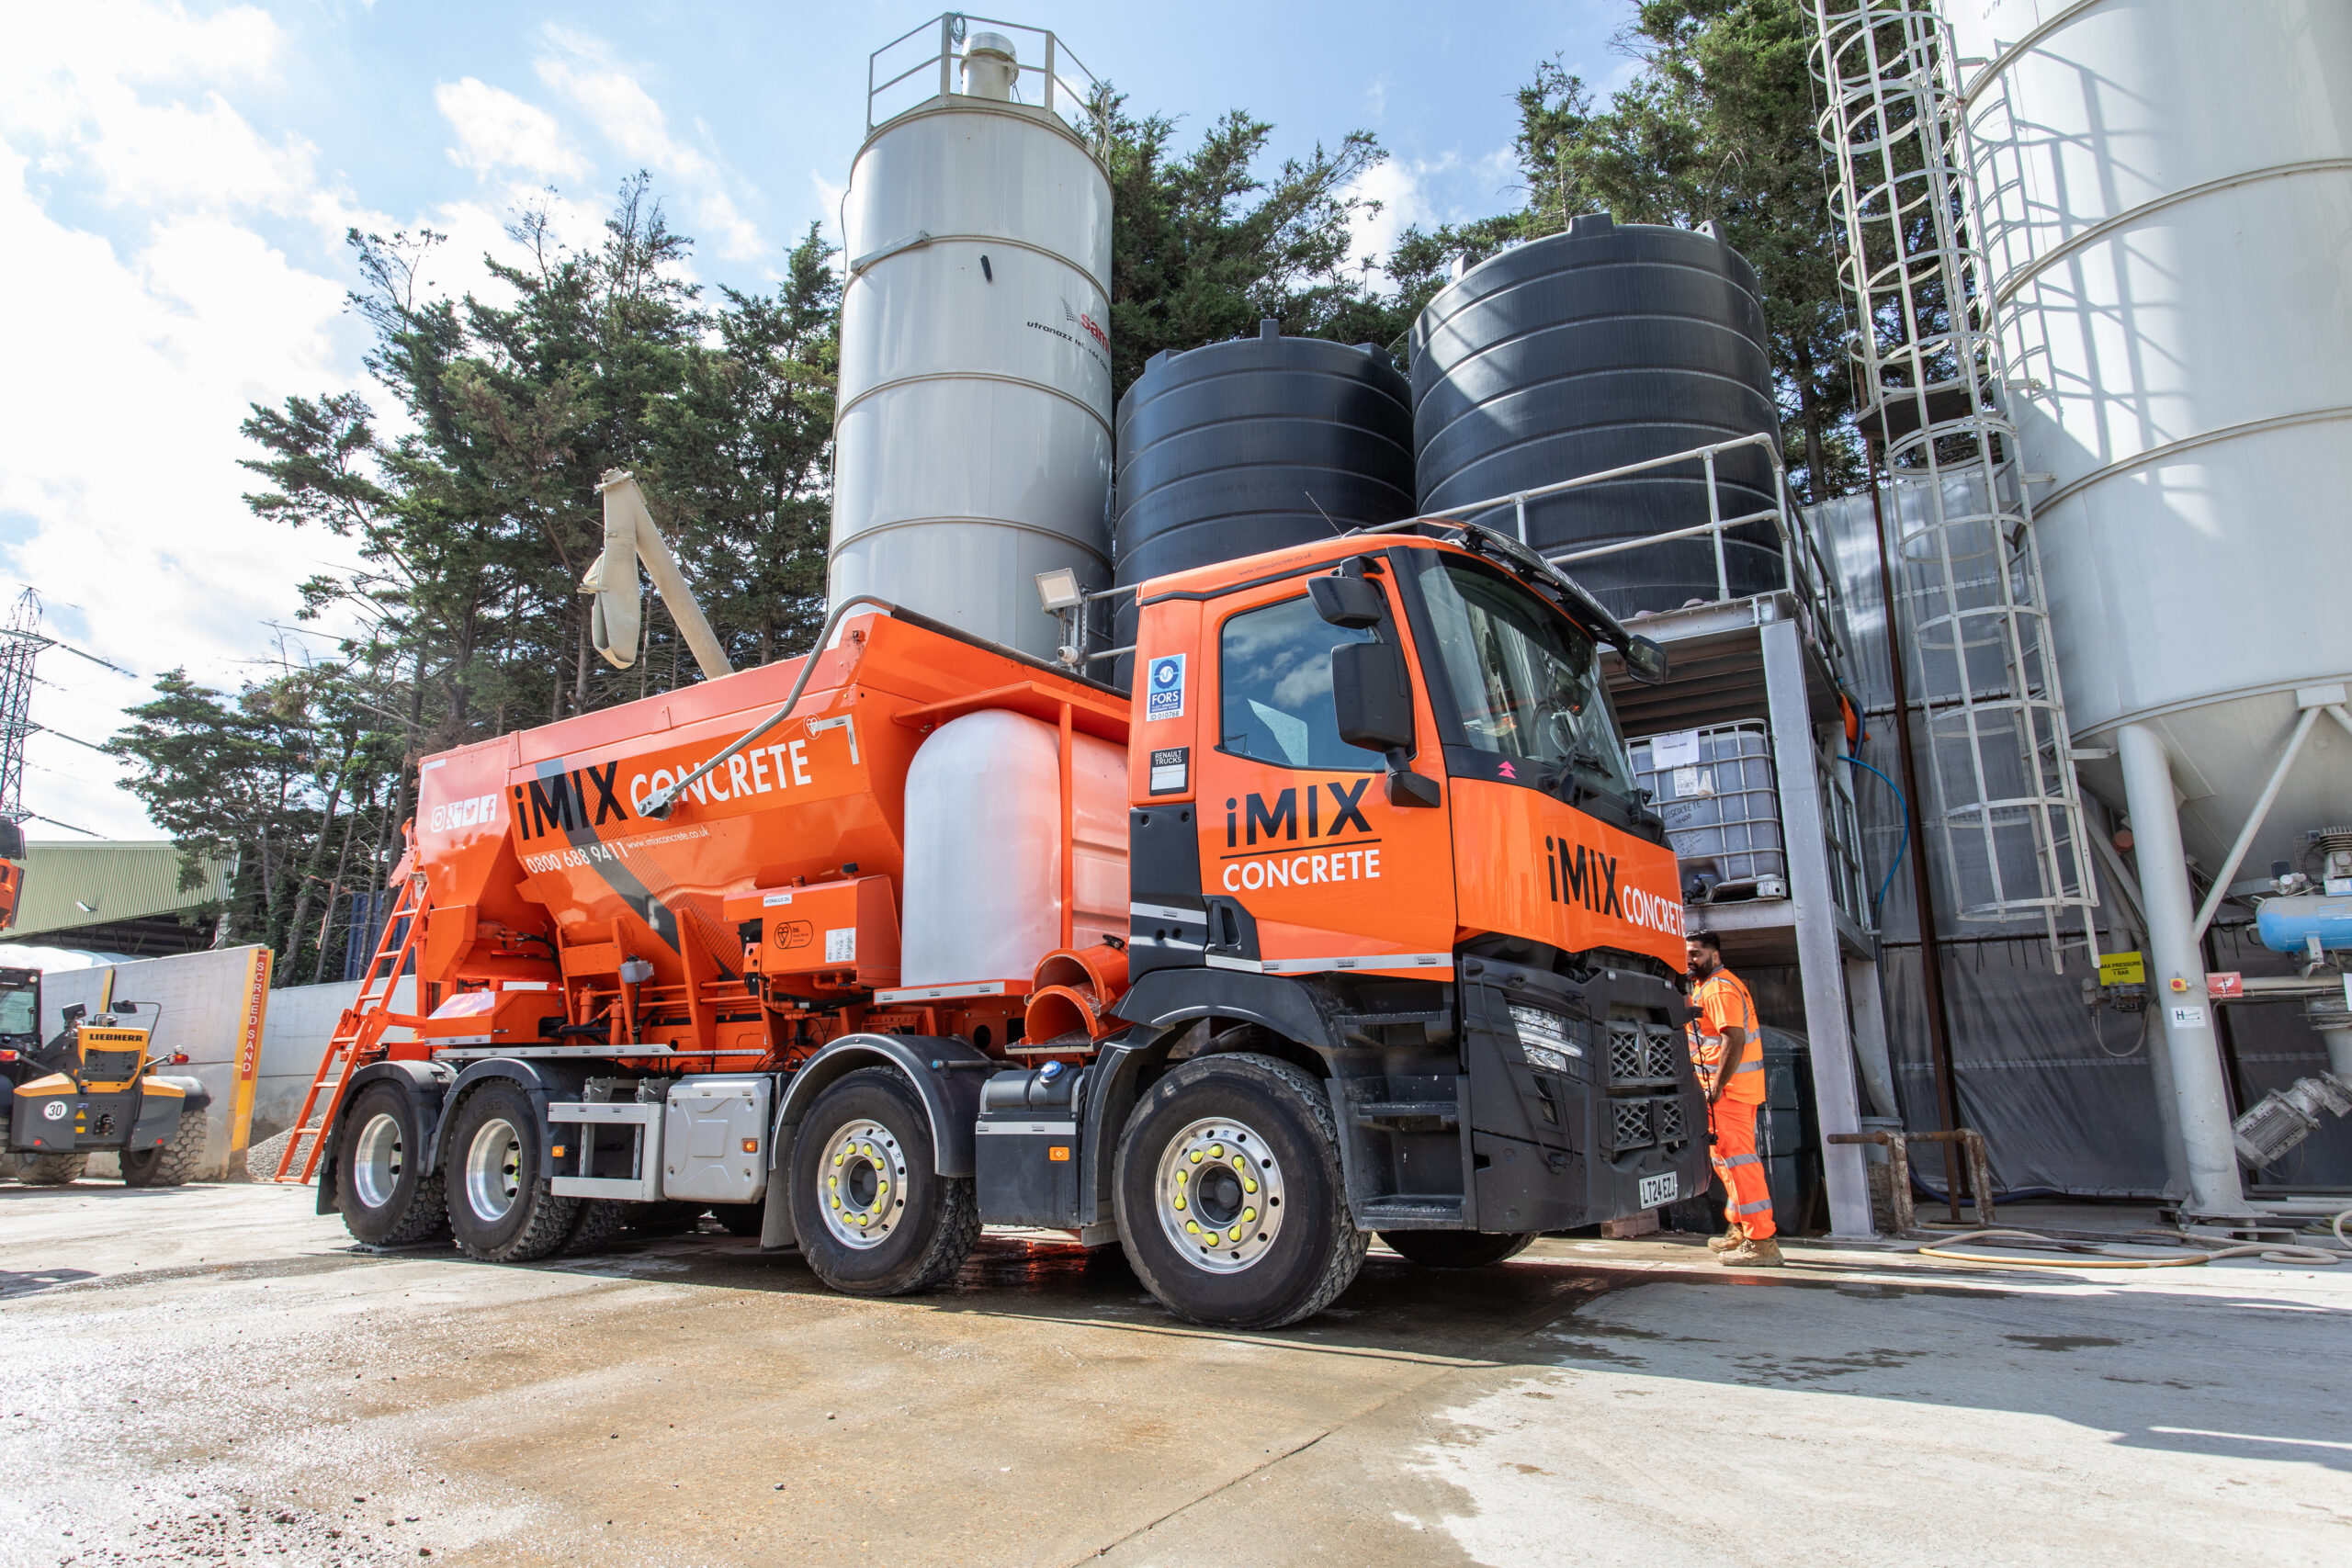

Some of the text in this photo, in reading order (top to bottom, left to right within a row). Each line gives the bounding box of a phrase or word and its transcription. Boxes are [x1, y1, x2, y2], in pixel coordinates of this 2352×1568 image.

[1152, 691, 1179, 705] FORS
[1155, 750, 1182, 760] RENAULT
[1155, 756, 1182, 765] TRUCKS
[514, 761, 628, 840] iMIX
[1226, 777, 1374, 848] iMIX
[627, 825, 710, 850] www.imixconcrete.co.uk
[526, 841, 628, 874] 0800 688 9411
[1223, 849, 1381, 892] CONCRETE
[1545, 835, 1687, 938] iMIX CONCRETE
[249, 962, 265, 1025] SCREED
[89, 1033, 143, 1042] LIEBHERR
[243, 1030, 255, 1072] SAND
[48, 1105, 63, 1117] 30
[1643, 1175, 1676, 1204] LT24 EZJ
